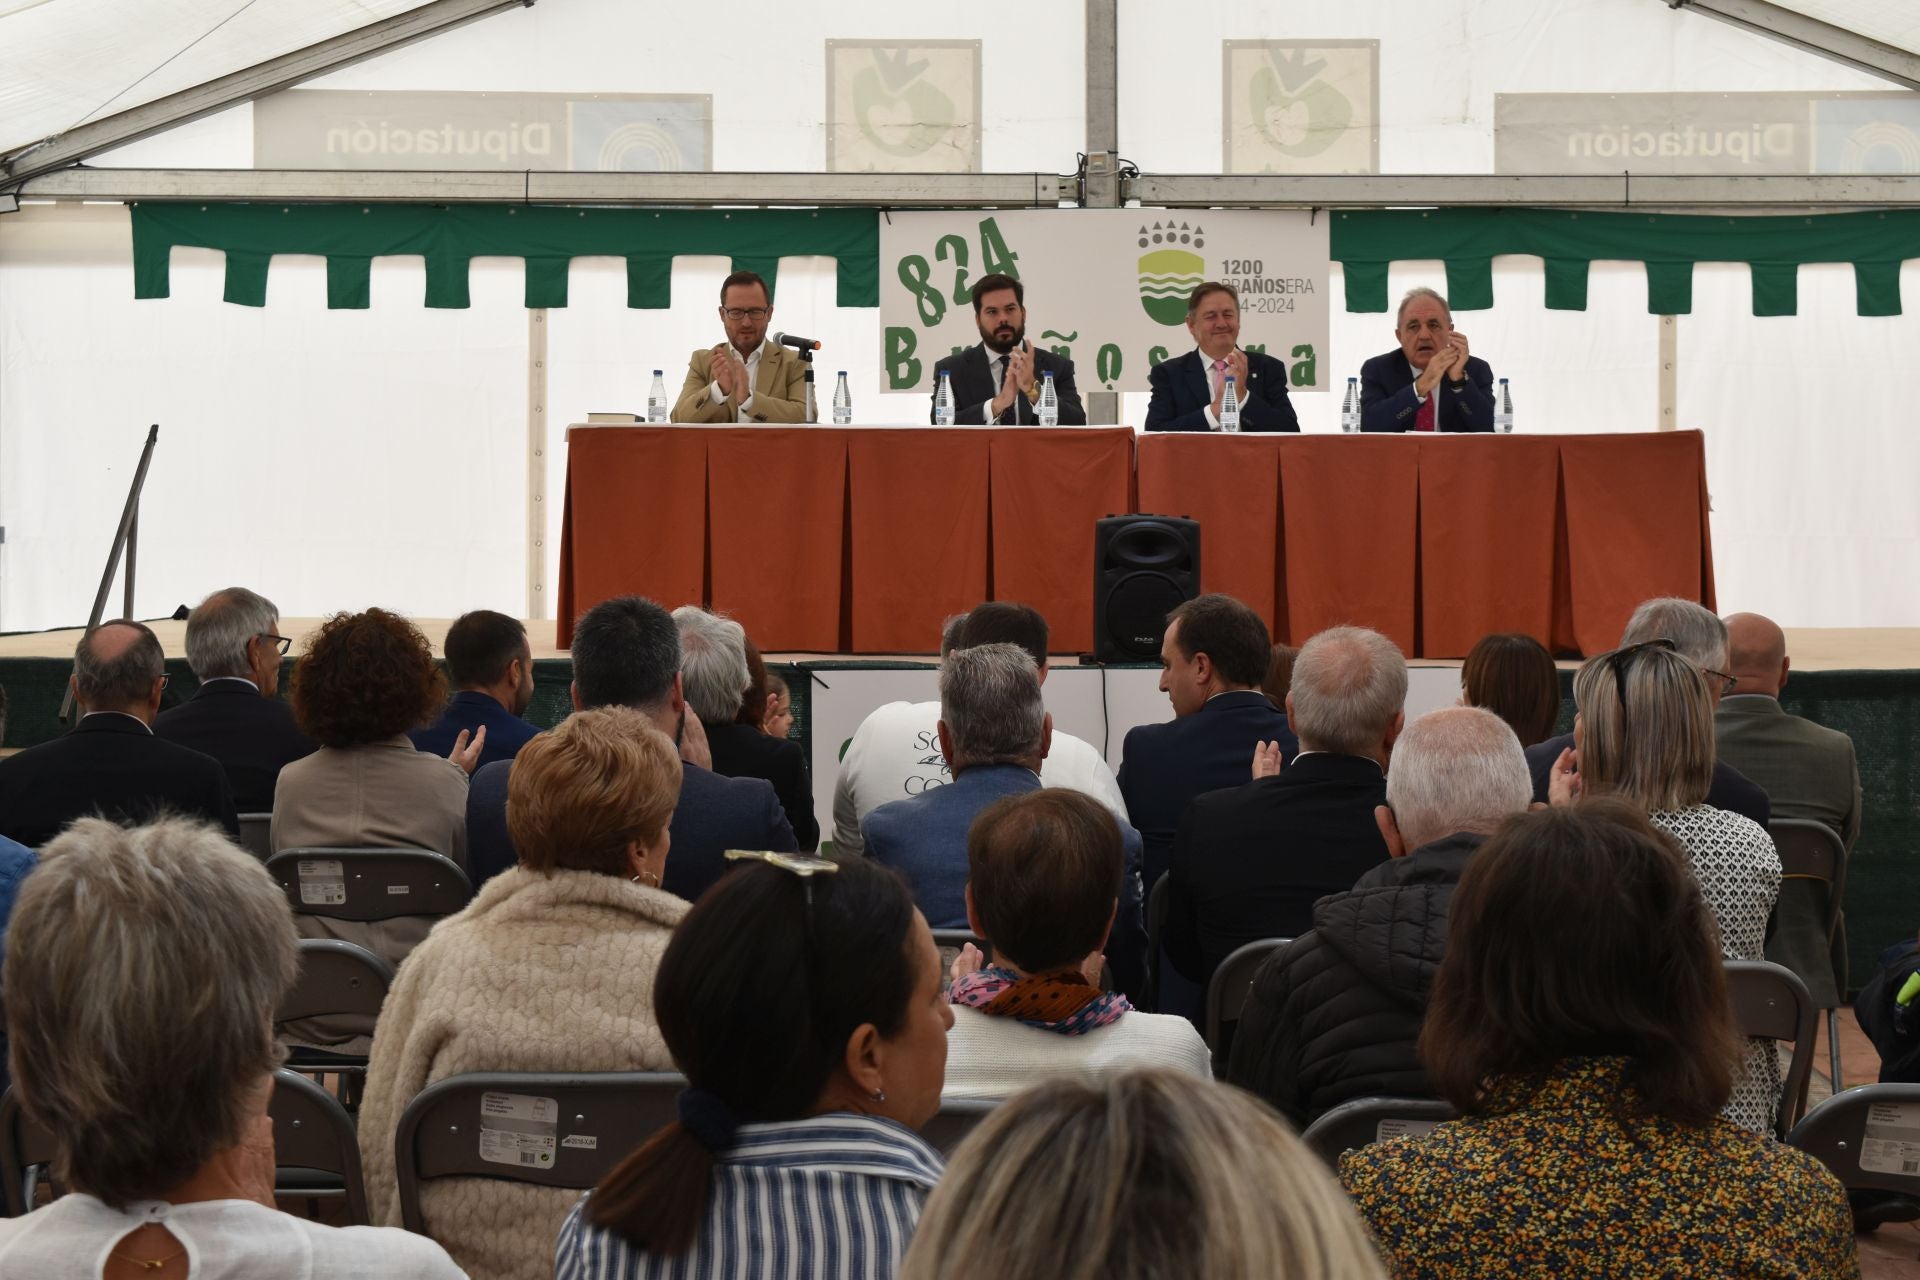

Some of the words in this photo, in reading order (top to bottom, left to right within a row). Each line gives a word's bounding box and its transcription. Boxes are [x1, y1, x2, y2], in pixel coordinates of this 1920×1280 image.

[897, 217, 1020, 327] 824
[1222, 259, 1263, 275] 1200
[1239, 297, 1296, 313] 4-2024
